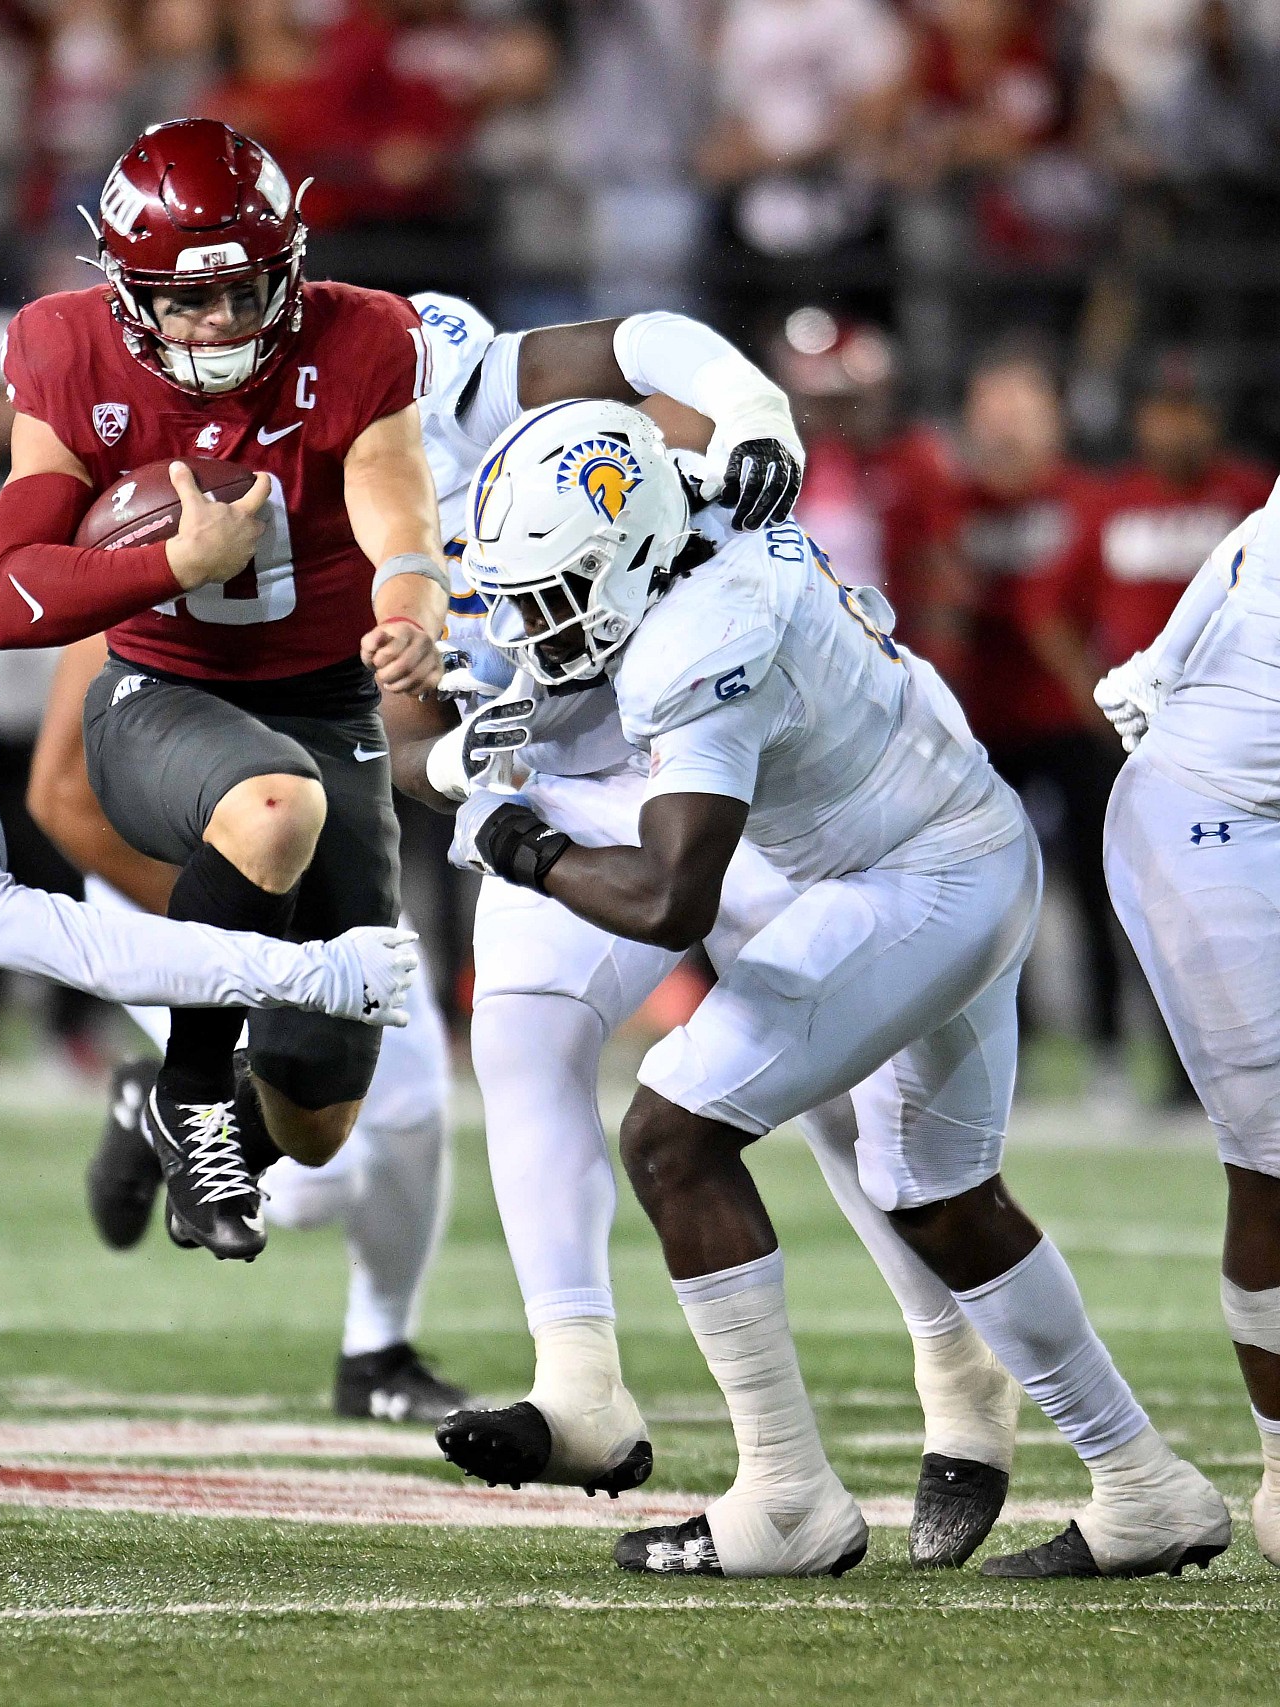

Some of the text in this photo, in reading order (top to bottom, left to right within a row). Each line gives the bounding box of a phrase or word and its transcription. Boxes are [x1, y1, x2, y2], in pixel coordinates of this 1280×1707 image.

[200, 251, 227, 268] WSU
[296, 365, 317, 410] C
[93, 404, 128, 430] PAC
[102, 421, 119, 437] 12
